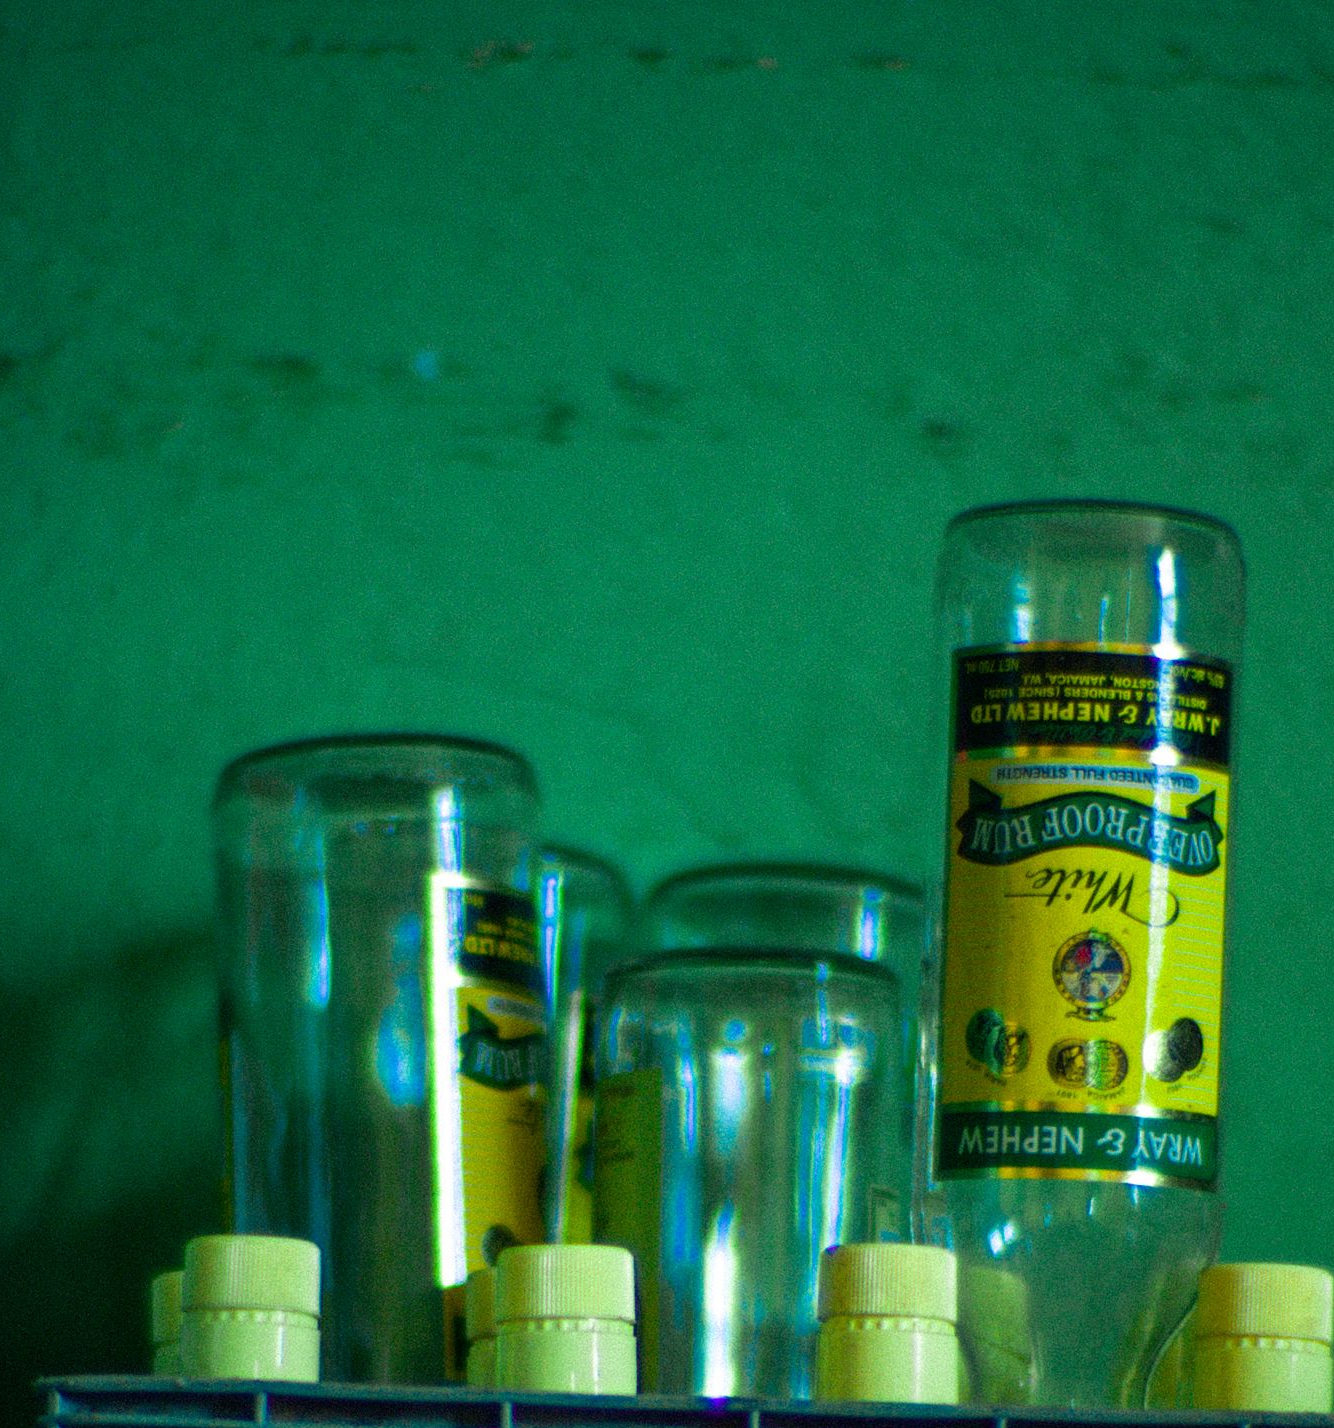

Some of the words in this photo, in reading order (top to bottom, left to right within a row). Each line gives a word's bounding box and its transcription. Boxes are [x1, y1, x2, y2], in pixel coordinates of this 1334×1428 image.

[1064, 686, 1131, 702] BLENDERS
[969, 703, 1002, 725] LTD
[1007, 701, 1111, 723] NEPHEW
[1119, 706, 1139, 725] &
[996, 766, 1069, 784] STRENGTH
[1071, 766, 1105, 784] FULL
[969, 814, 1035, 855] RUM
[1004, 867, 1180, 929] White
[957, 1125, 1085, 1155] NEPHEW
[1096, 1127, 1127, 1156] &
[1131, 1128, 1203, 1167] WRAY
